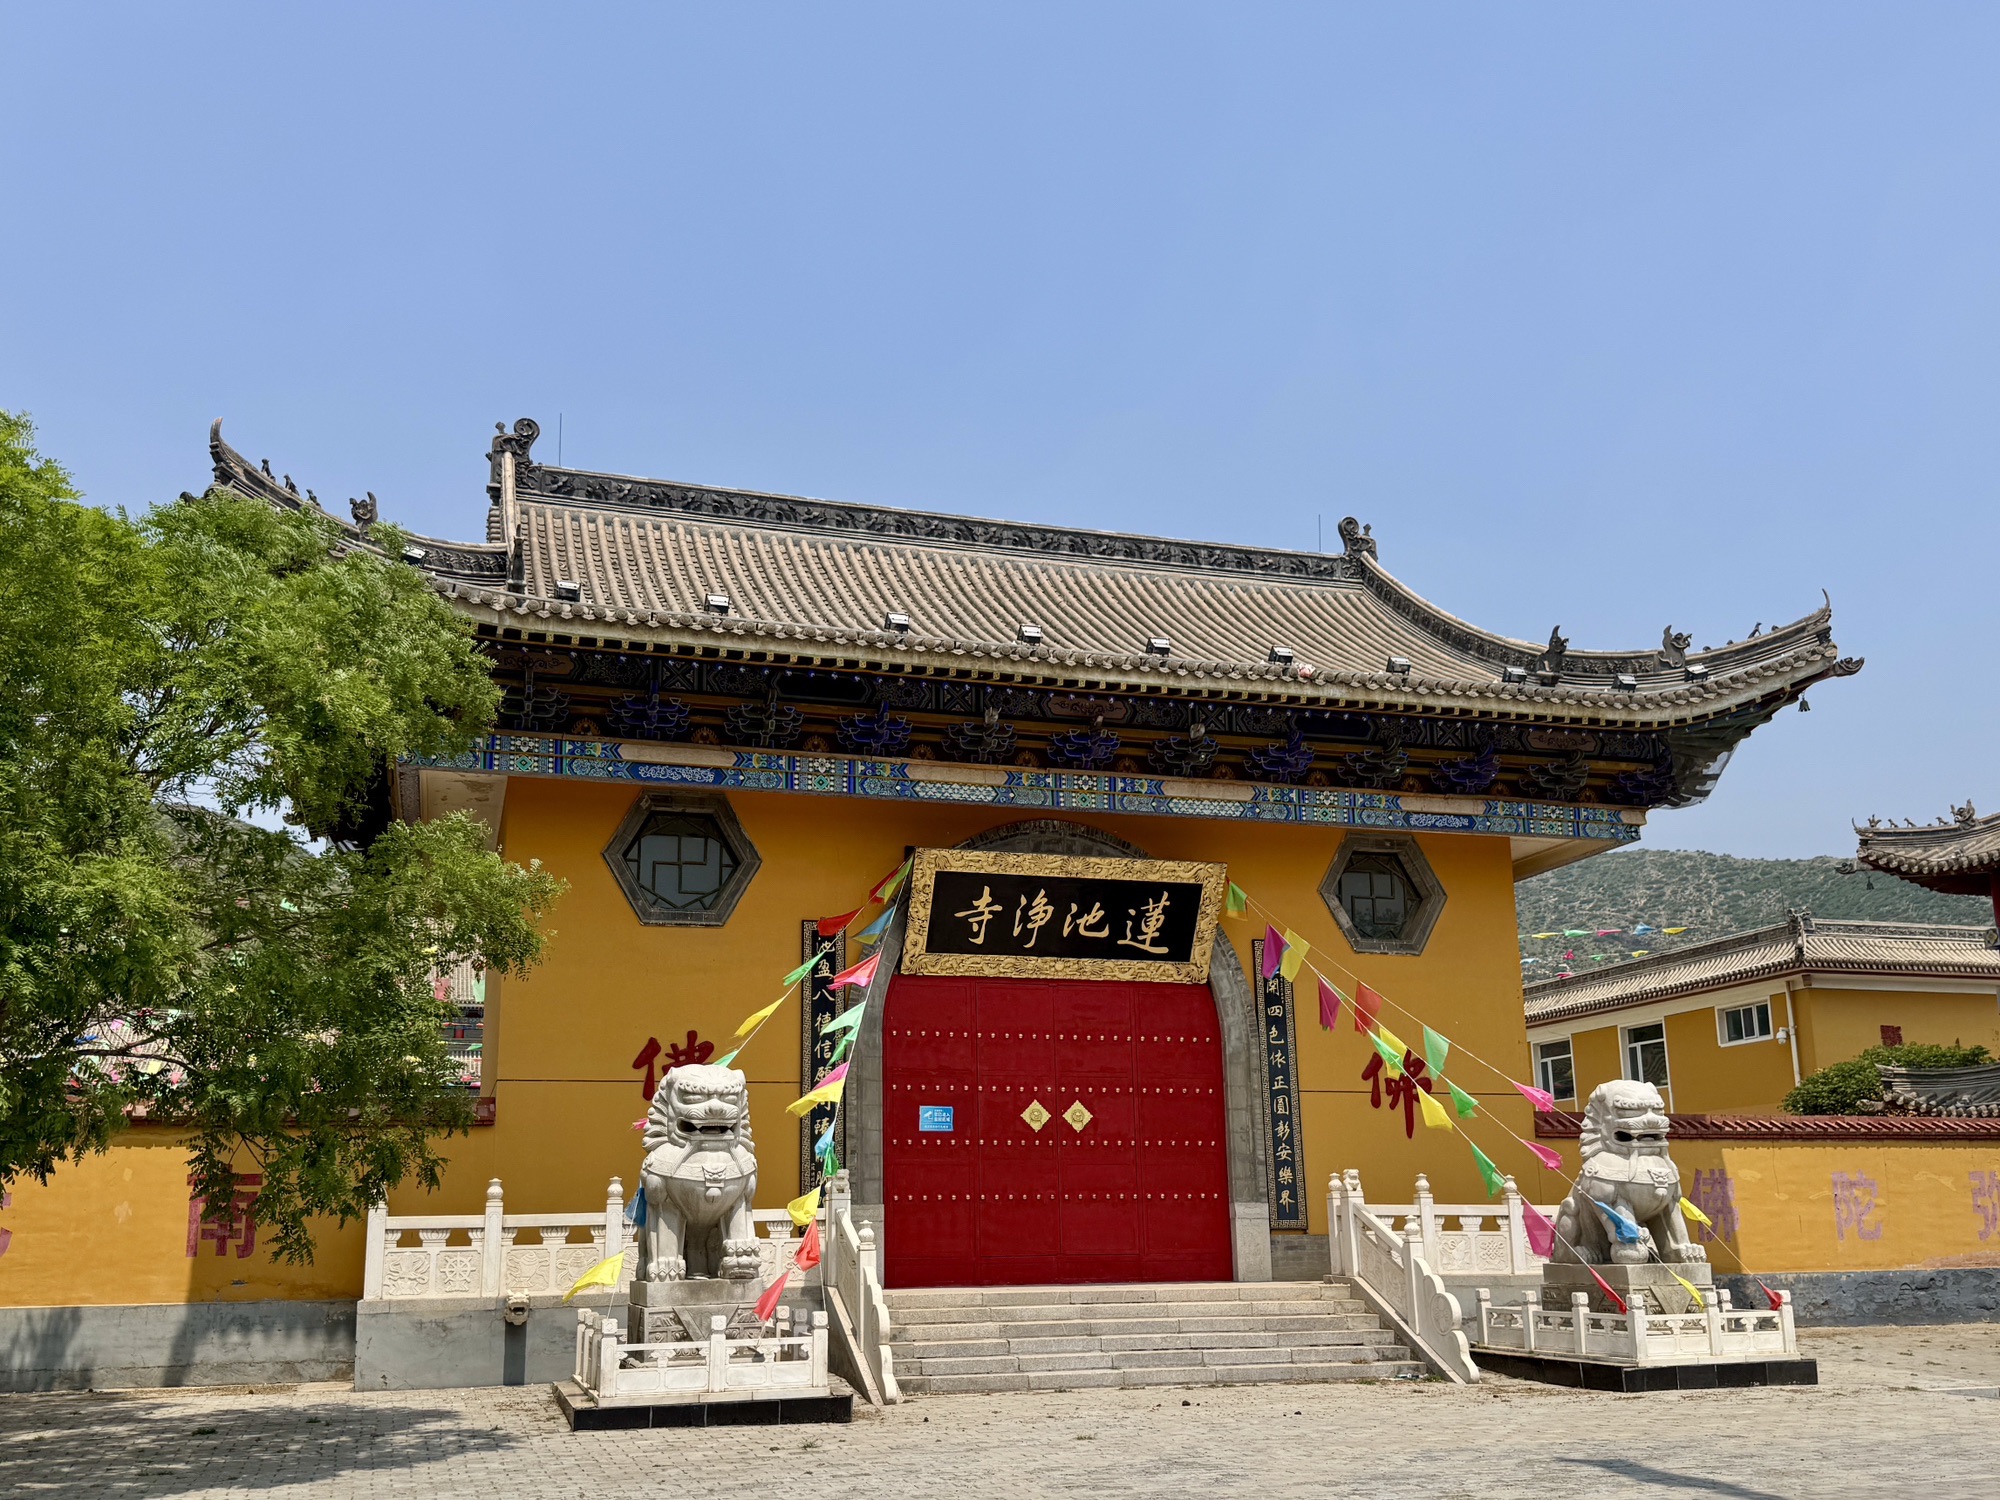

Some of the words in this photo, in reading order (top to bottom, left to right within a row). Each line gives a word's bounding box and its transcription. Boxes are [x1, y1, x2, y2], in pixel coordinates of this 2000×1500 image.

[1266, 970, 1296, 1213] 開四色依正圓彰安樂界
[1361, 1048, 1433, 1139] 佛
[186, 1164, 263, 1259] 南
[1690, 1168, 1740, 1242] 佛
[1831, 1169, 1883, 1241] 陀
